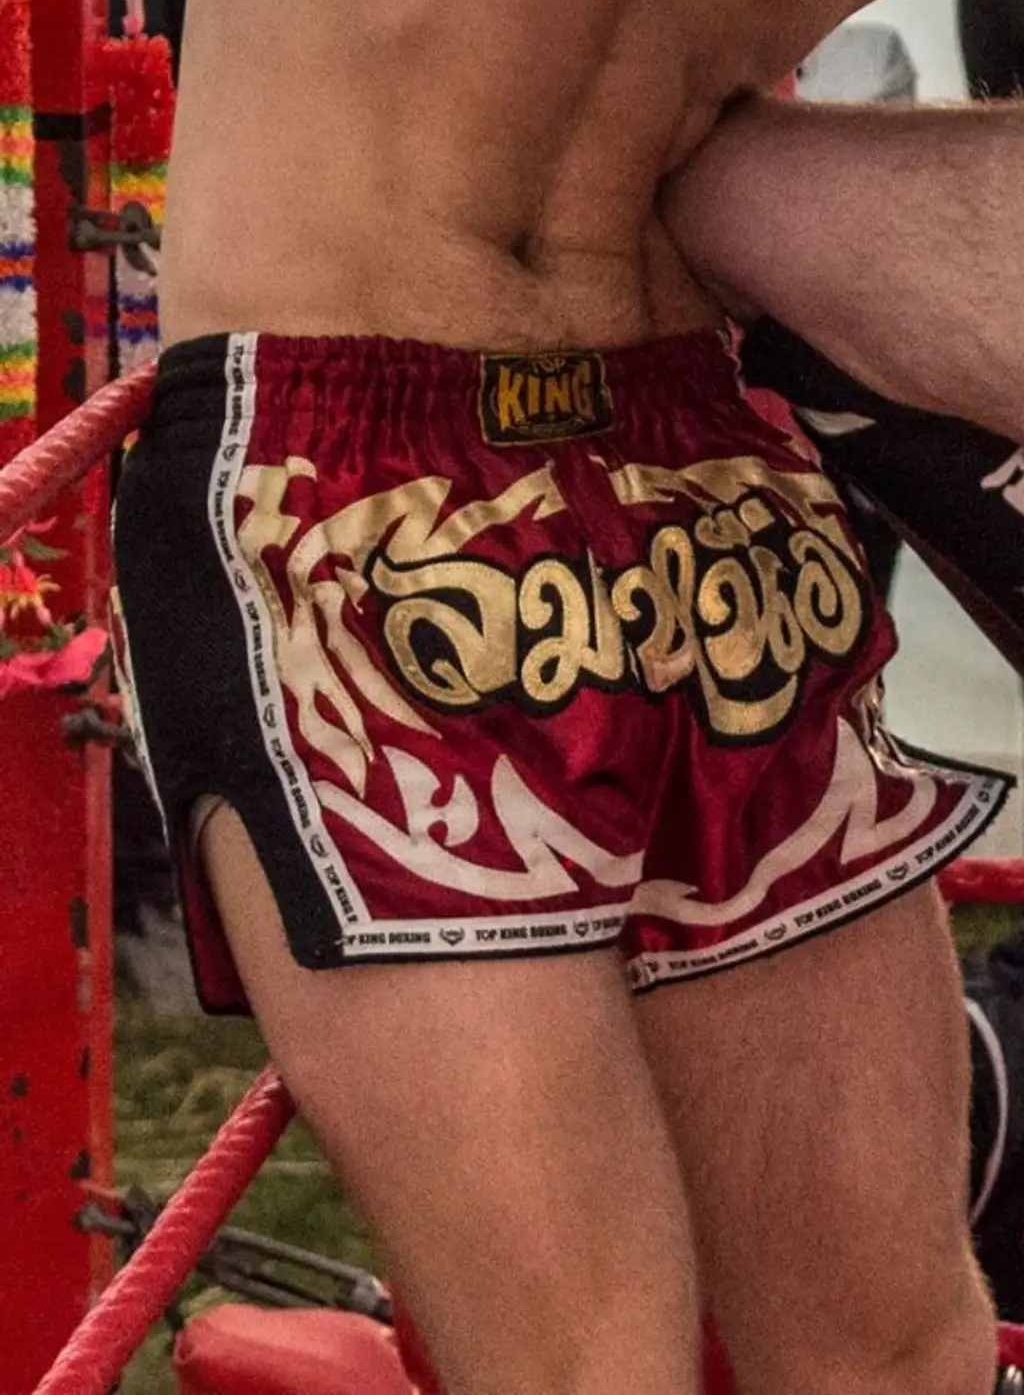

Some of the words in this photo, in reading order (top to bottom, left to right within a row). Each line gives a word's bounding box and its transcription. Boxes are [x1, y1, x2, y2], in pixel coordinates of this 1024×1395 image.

[498, 361, 595, 432] KING
[357, 931, 386, 946] KING
[388, 931, 432, 945] BOXING
[474, 928, 498, 942] TOP
[499, 926, 528, 940] KING
